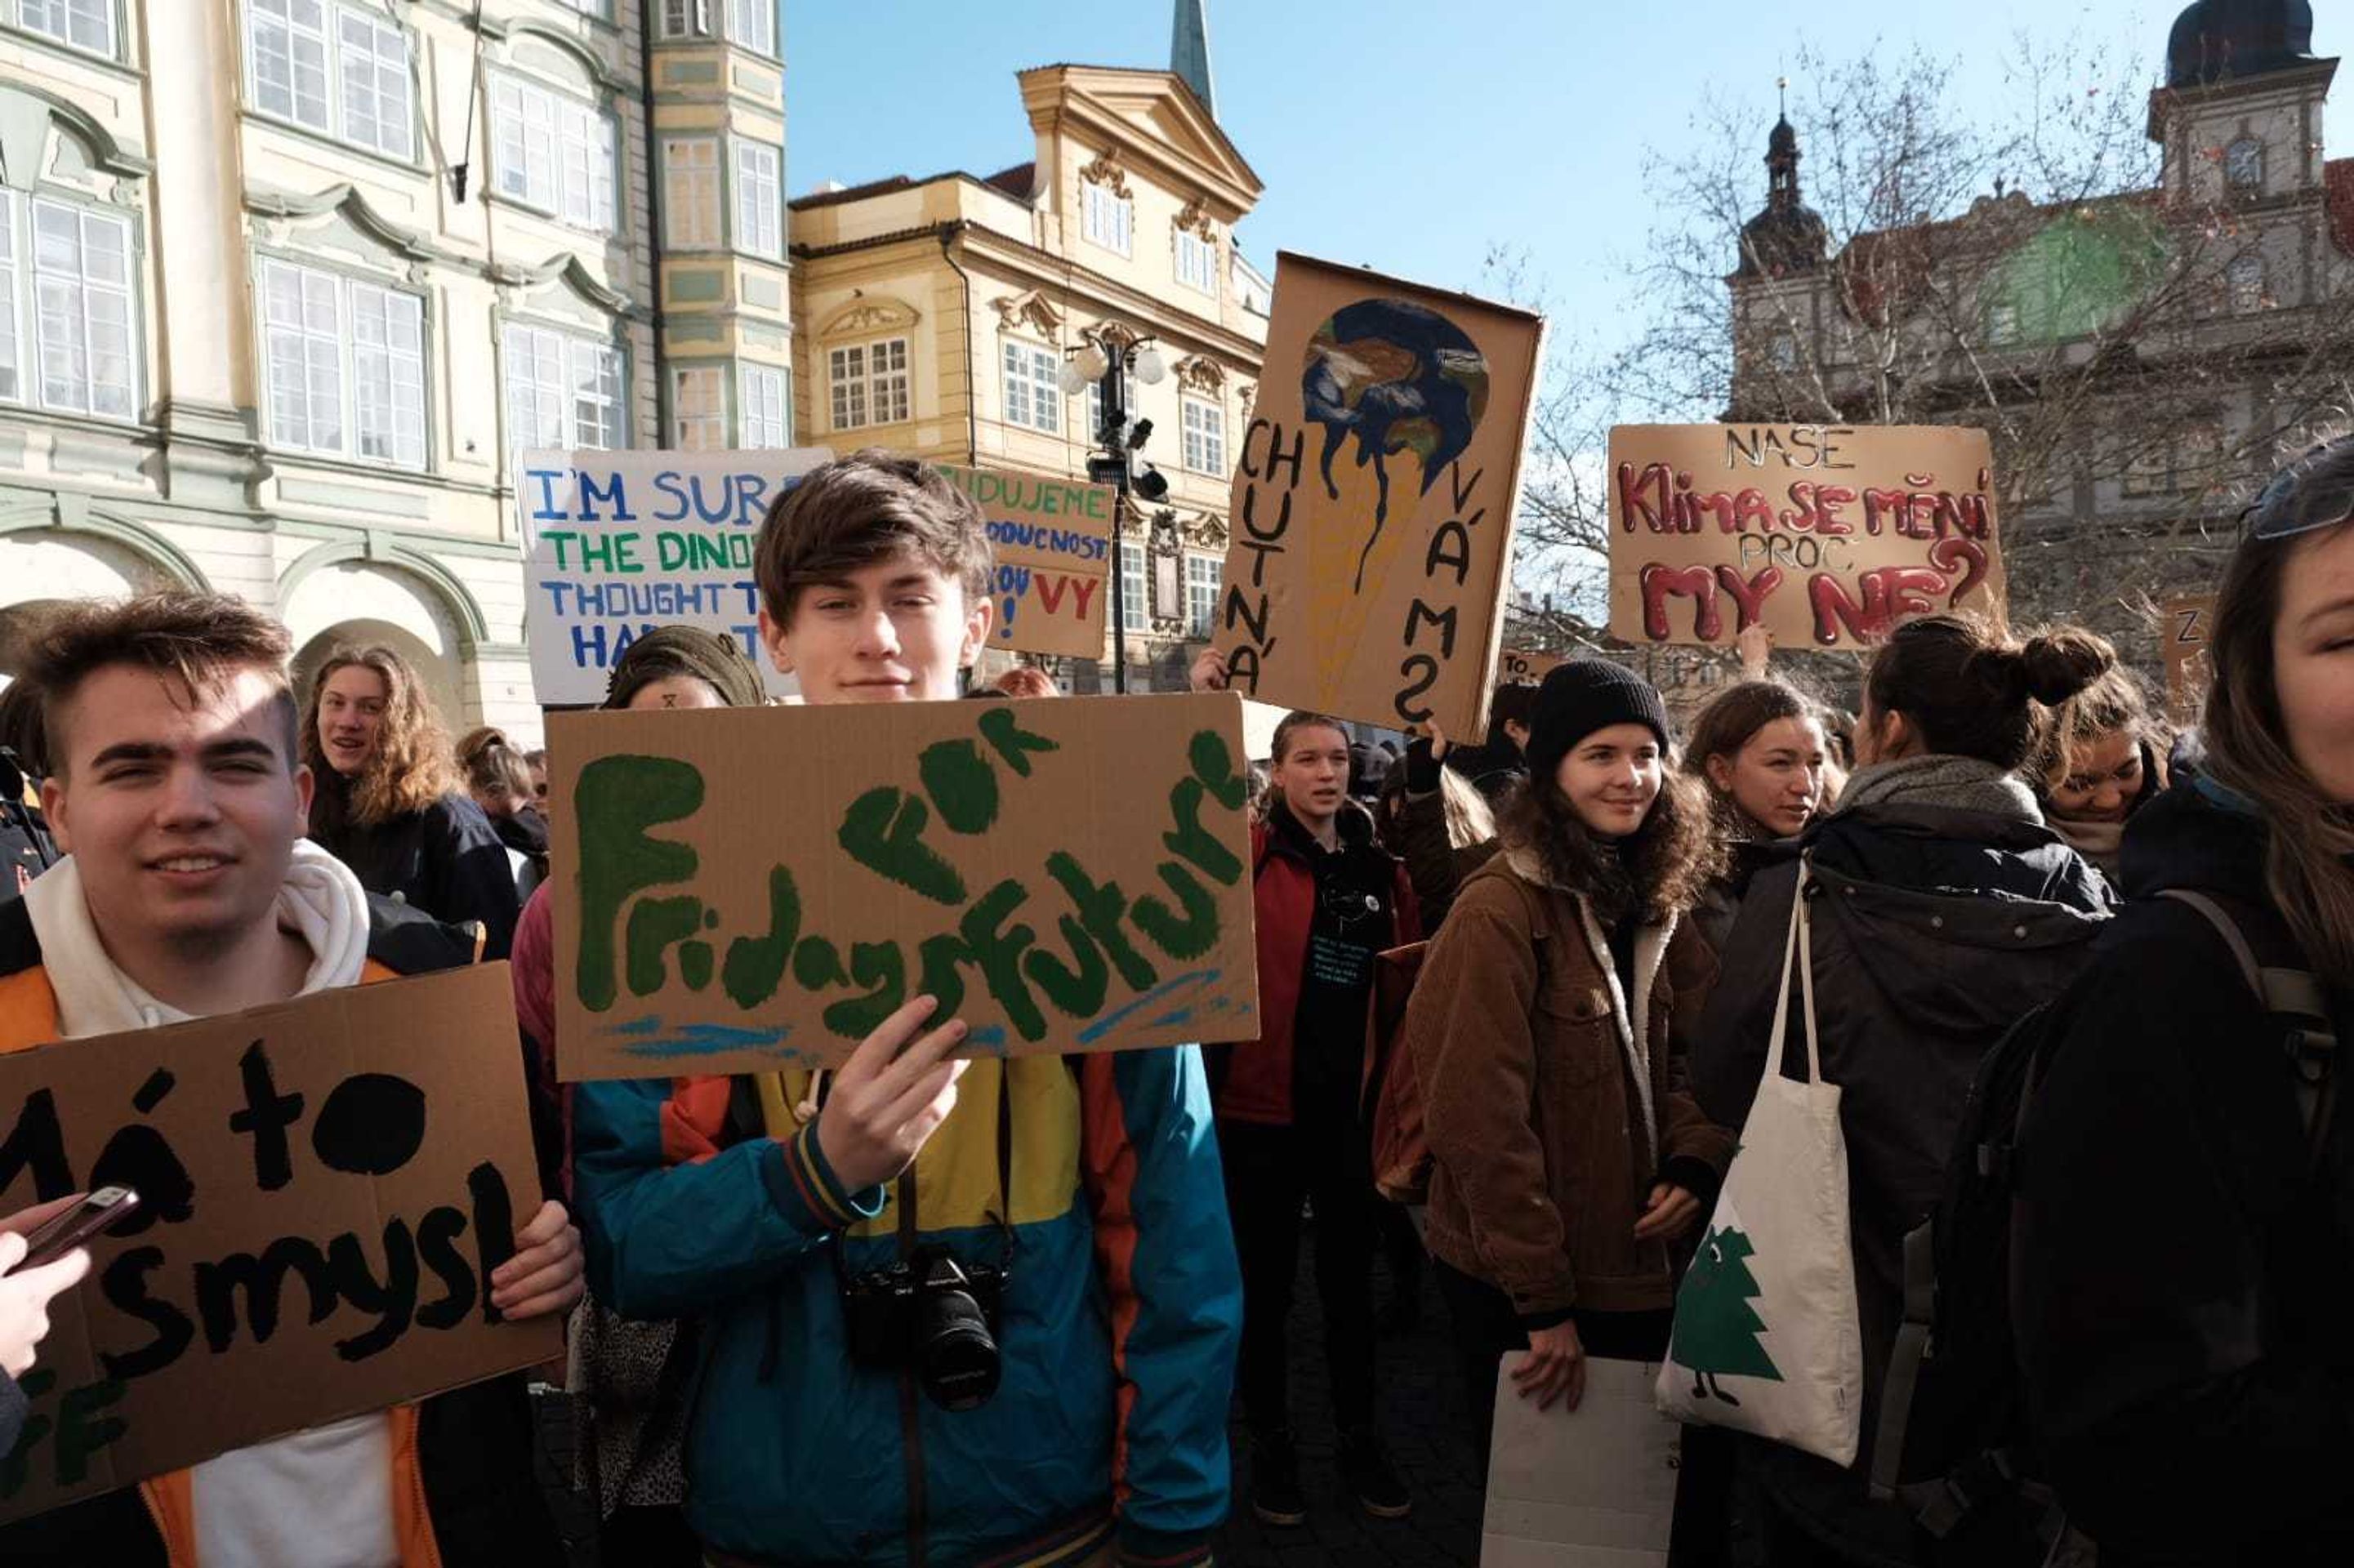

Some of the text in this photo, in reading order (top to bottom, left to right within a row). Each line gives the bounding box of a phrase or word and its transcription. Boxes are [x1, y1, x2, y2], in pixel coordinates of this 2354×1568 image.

[527, 468, 804, 526] I'M SUR
[1780, 481, 1857, 535] SE
[540, 532, 760, 572] THE DINO
[540, 581, 726, 617] THOUGHT
[1033, 573, 1098, 621] VY
[1639, 562, 1783, 642] MY
[572, 622, 658, 668] HA
[229, 1038, 427, 1192] to
